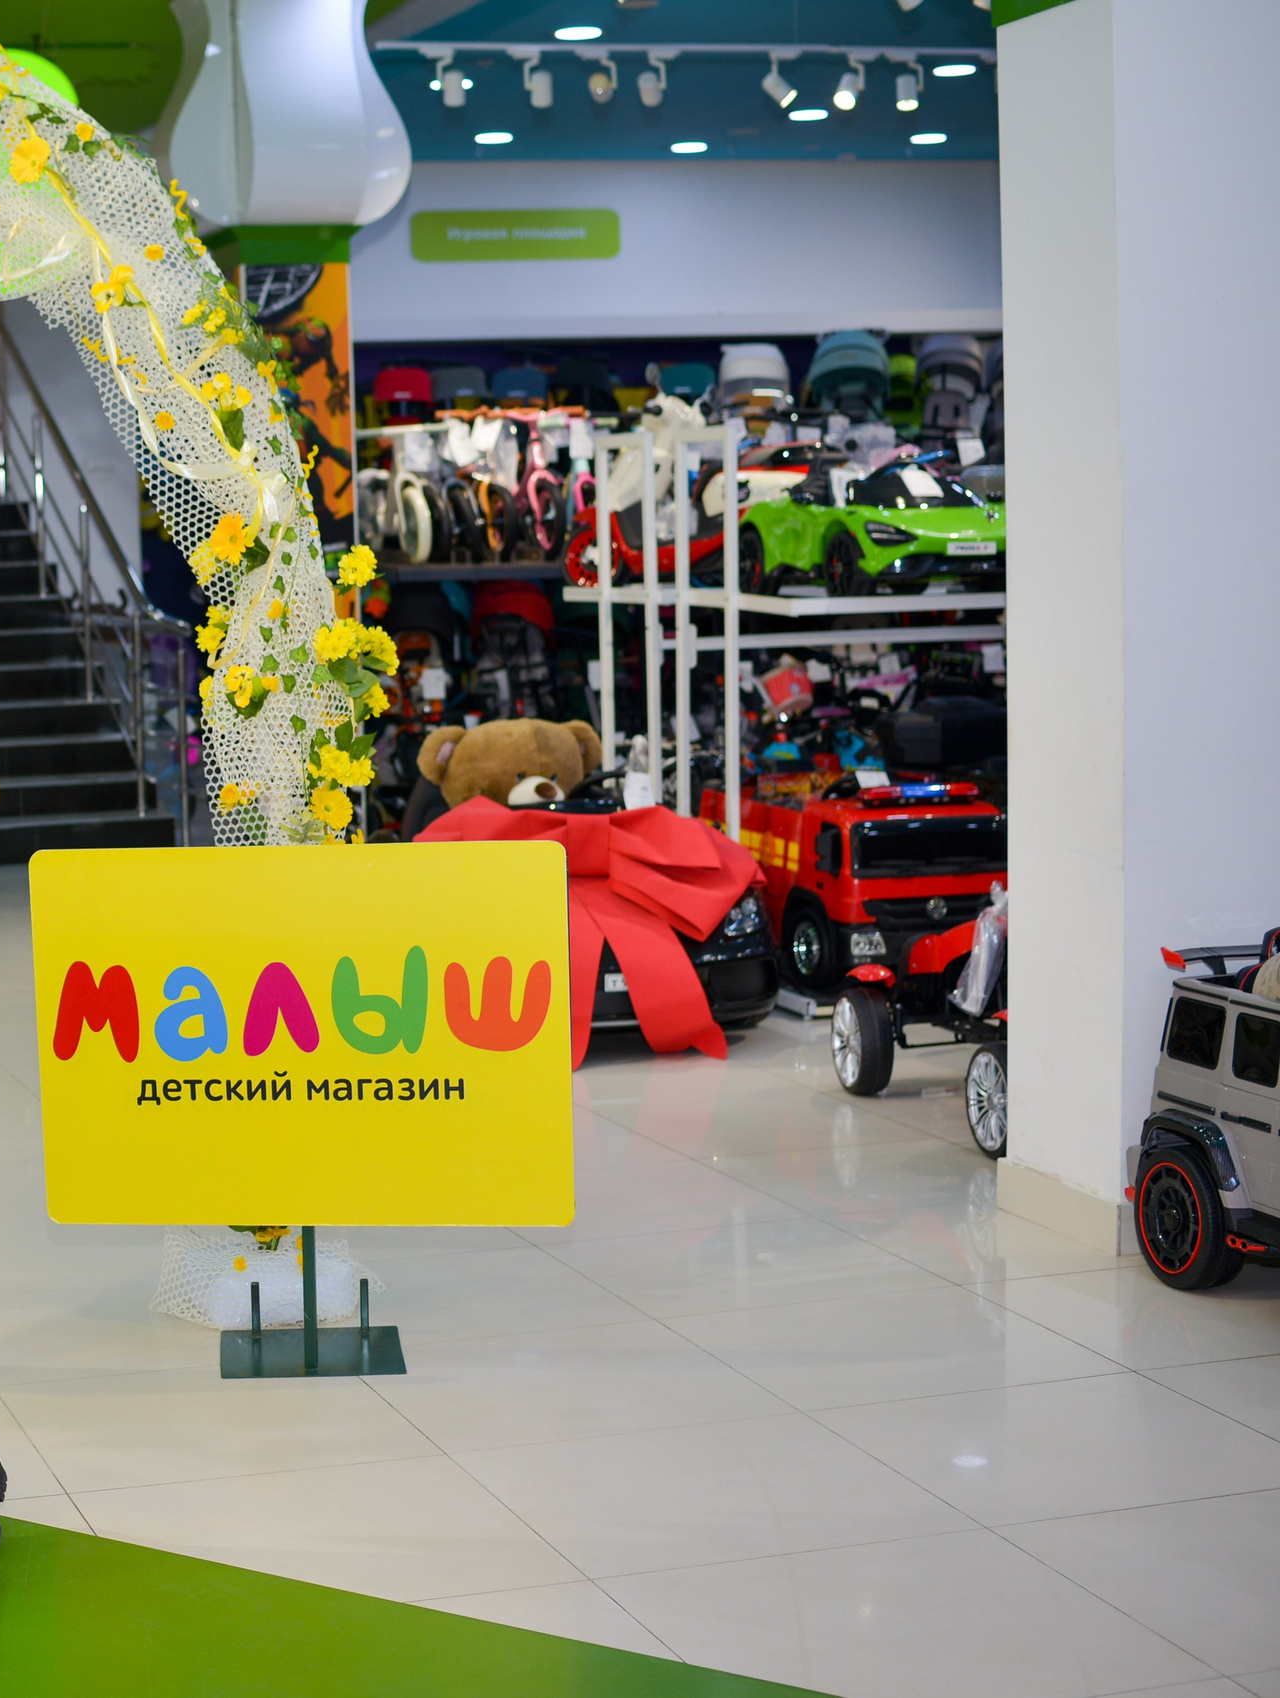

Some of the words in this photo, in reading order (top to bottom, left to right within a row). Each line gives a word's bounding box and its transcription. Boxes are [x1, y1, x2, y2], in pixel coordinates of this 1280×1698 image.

[447, 226, 508, 243] Игровая
[511, 226, 586, 241] площадка
[137, 1070, 292, 1106] детский
[306, 1075, 465, 1101] магазин
